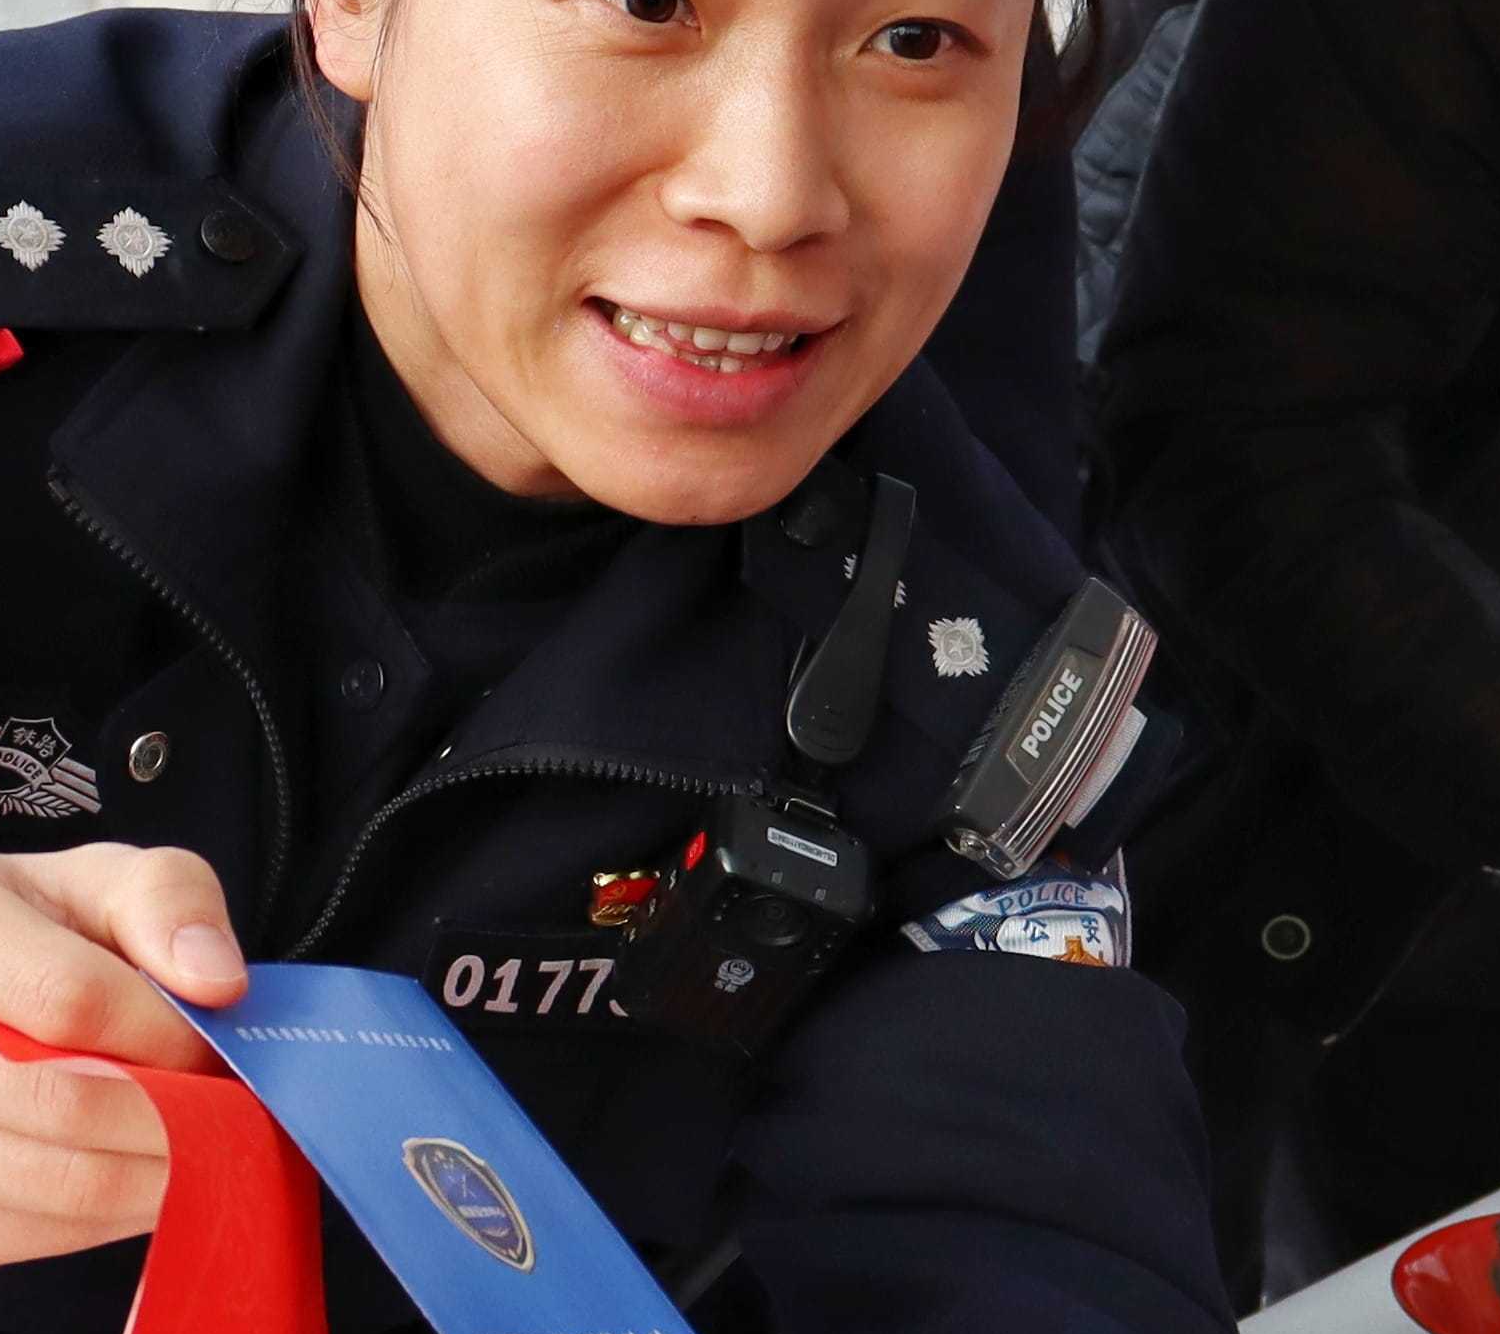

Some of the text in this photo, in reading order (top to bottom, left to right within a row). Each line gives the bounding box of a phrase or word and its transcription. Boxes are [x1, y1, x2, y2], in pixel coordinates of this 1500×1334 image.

[1021, 668, 1084, 759] POLICE
[13, 726, 58, 758] 铁路
[995, 881, 1088, 917] POLICE
[443, 954, 629, 1017] 0177
